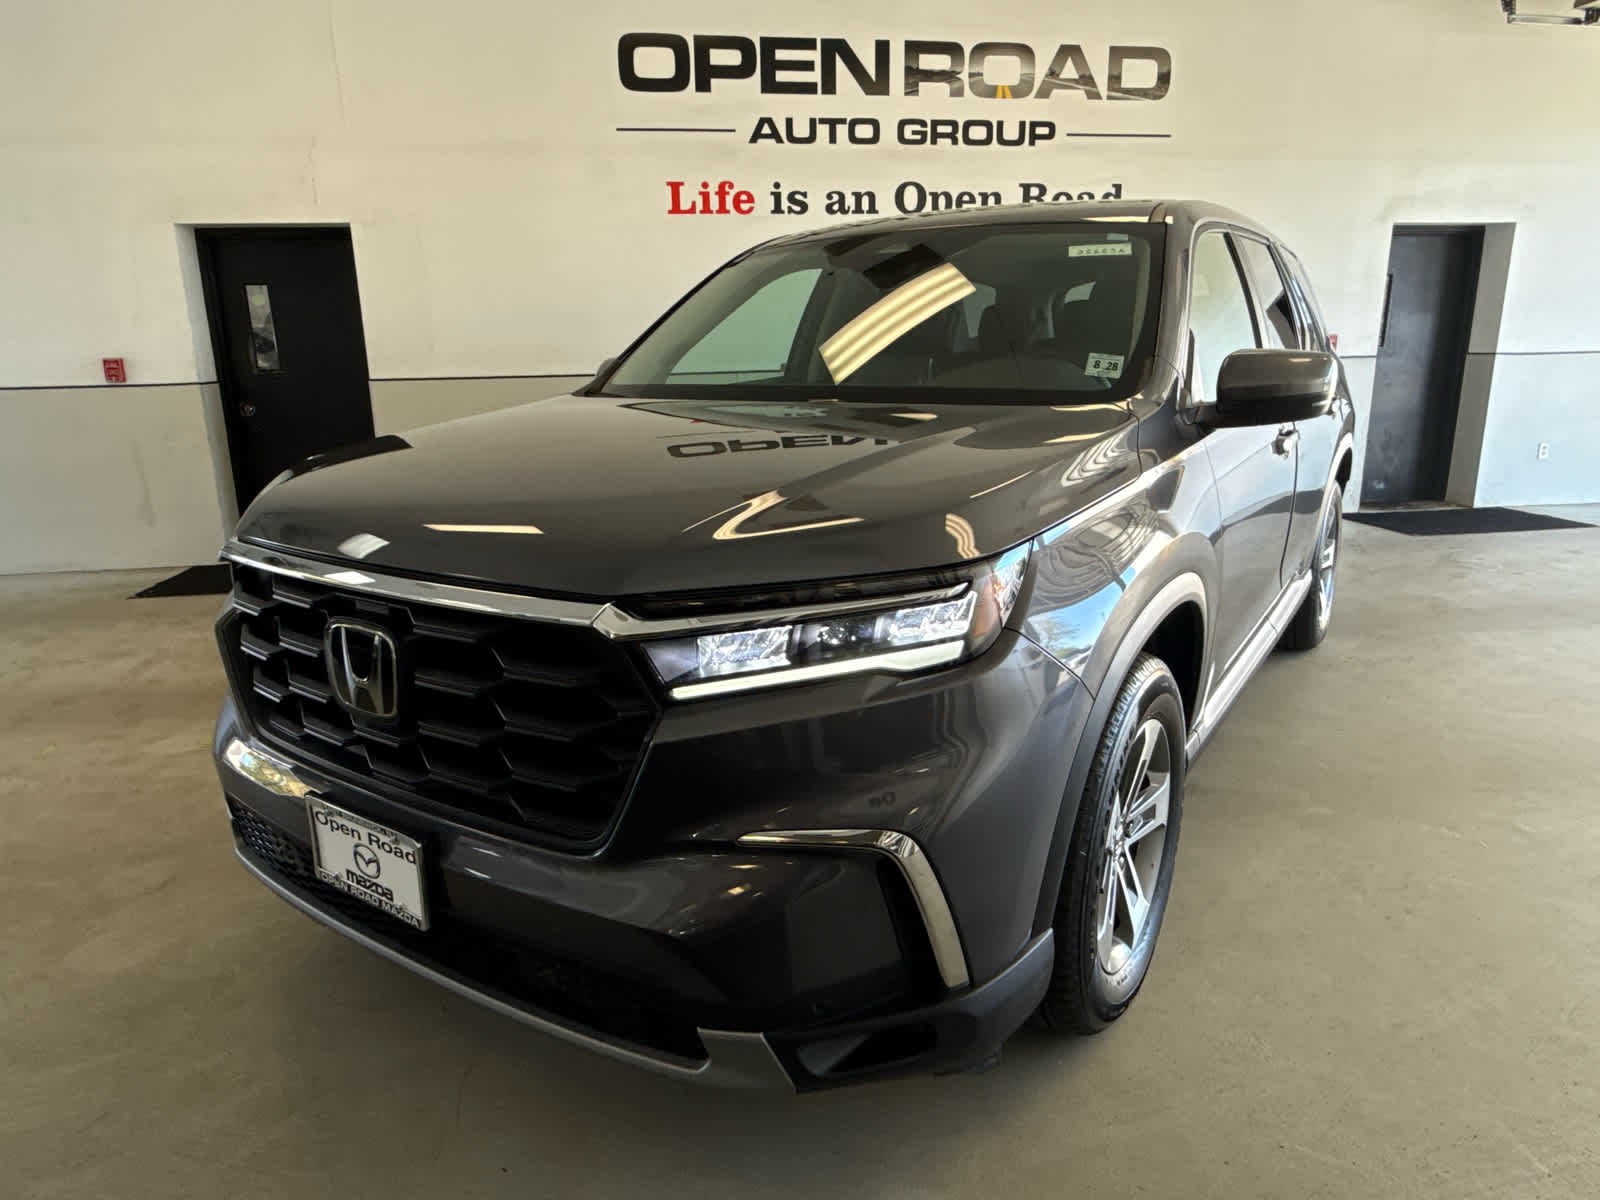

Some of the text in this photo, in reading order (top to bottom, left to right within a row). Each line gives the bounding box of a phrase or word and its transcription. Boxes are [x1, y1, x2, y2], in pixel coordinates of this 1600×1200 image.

[617, 32, 1172, 101] OPEN ROAD
[748, 116, 1056, 147] AUTO GROUP
[665, 180, 755, 215] Life
[770, 181, 809, 215] is
[825, 190, 879, 215] an
[315, 810, 362, 841] Open
[367, 832, 417, 865] Road
[345, 868, 394, 903] mazda
